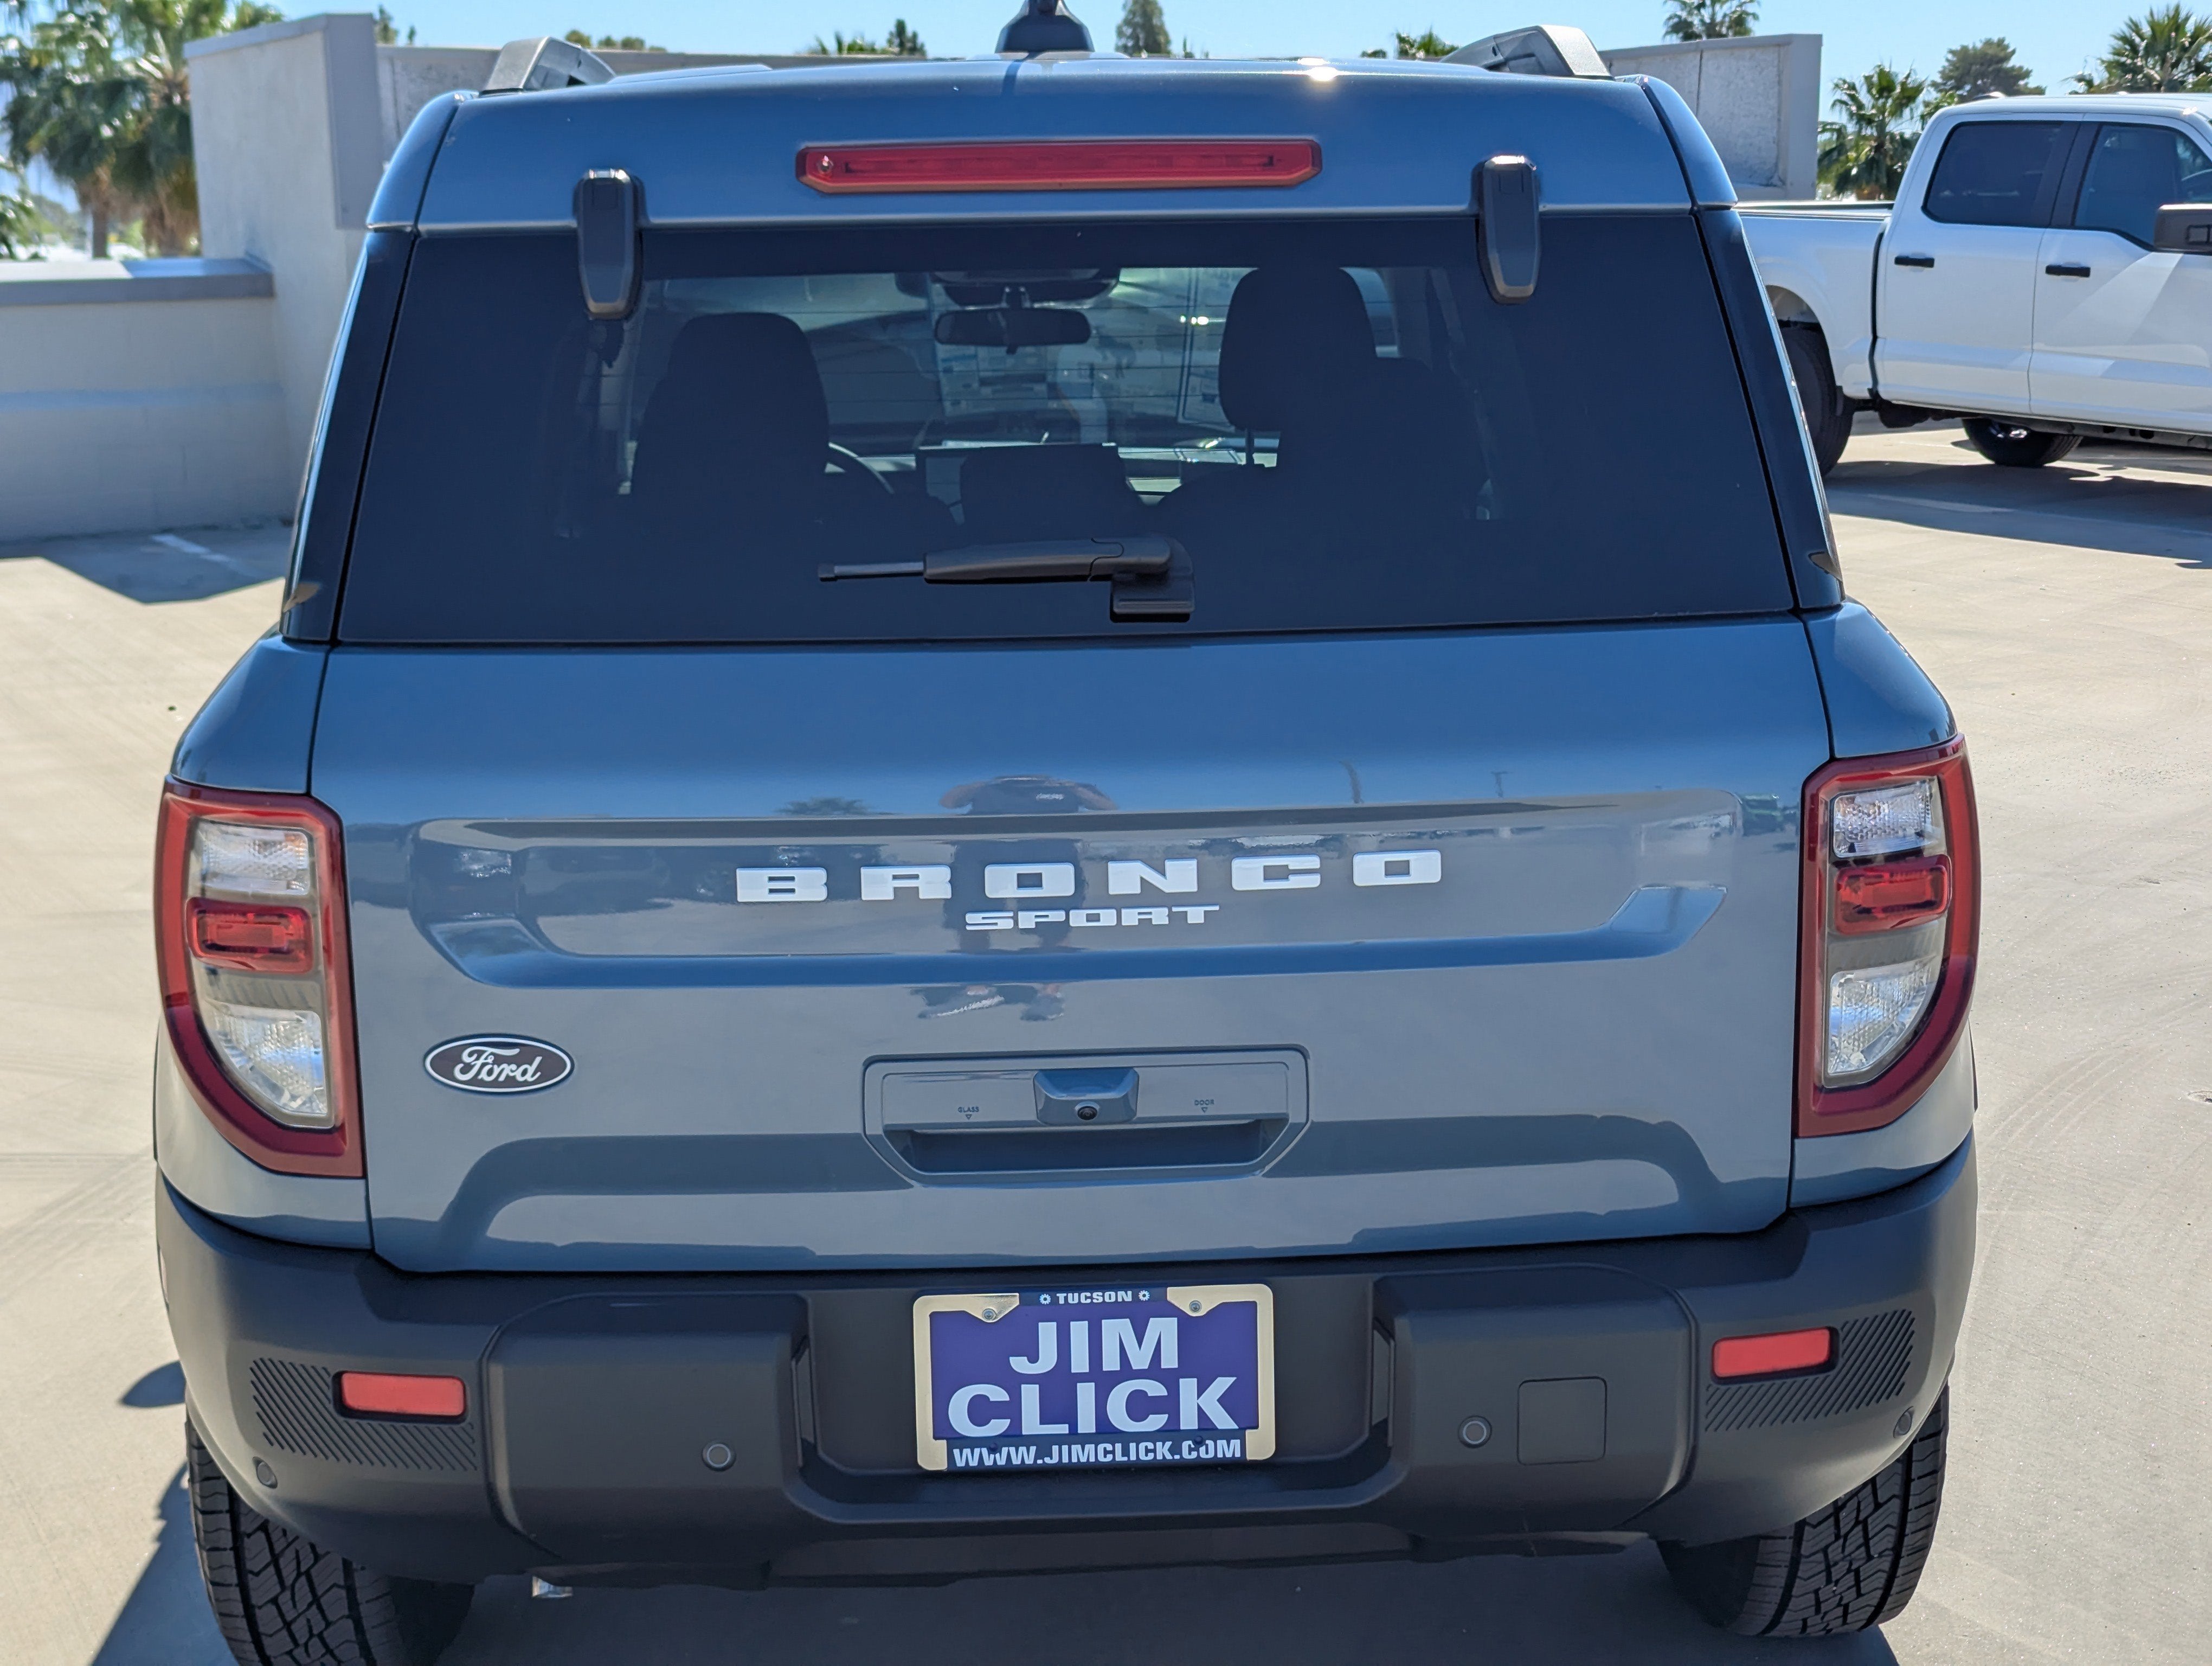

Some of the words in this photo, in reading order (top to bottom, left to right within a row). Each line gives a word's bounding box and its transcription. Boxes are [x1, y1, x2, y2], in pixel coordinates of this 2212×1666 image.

[736, 849, 1442, 902] BRONCO
[965, 905, 1220, 931] SPORT
[454, 1046, 542, 1081] Ford
[1056, 1291, 1133, 1305] TUCSON
[1009, 1317, 1178, 1374] JIM
[948, 1376, 1239, 1437] CLICK
[953, 1439, 1240, 1467] WWW.JIMCLICK.COM
